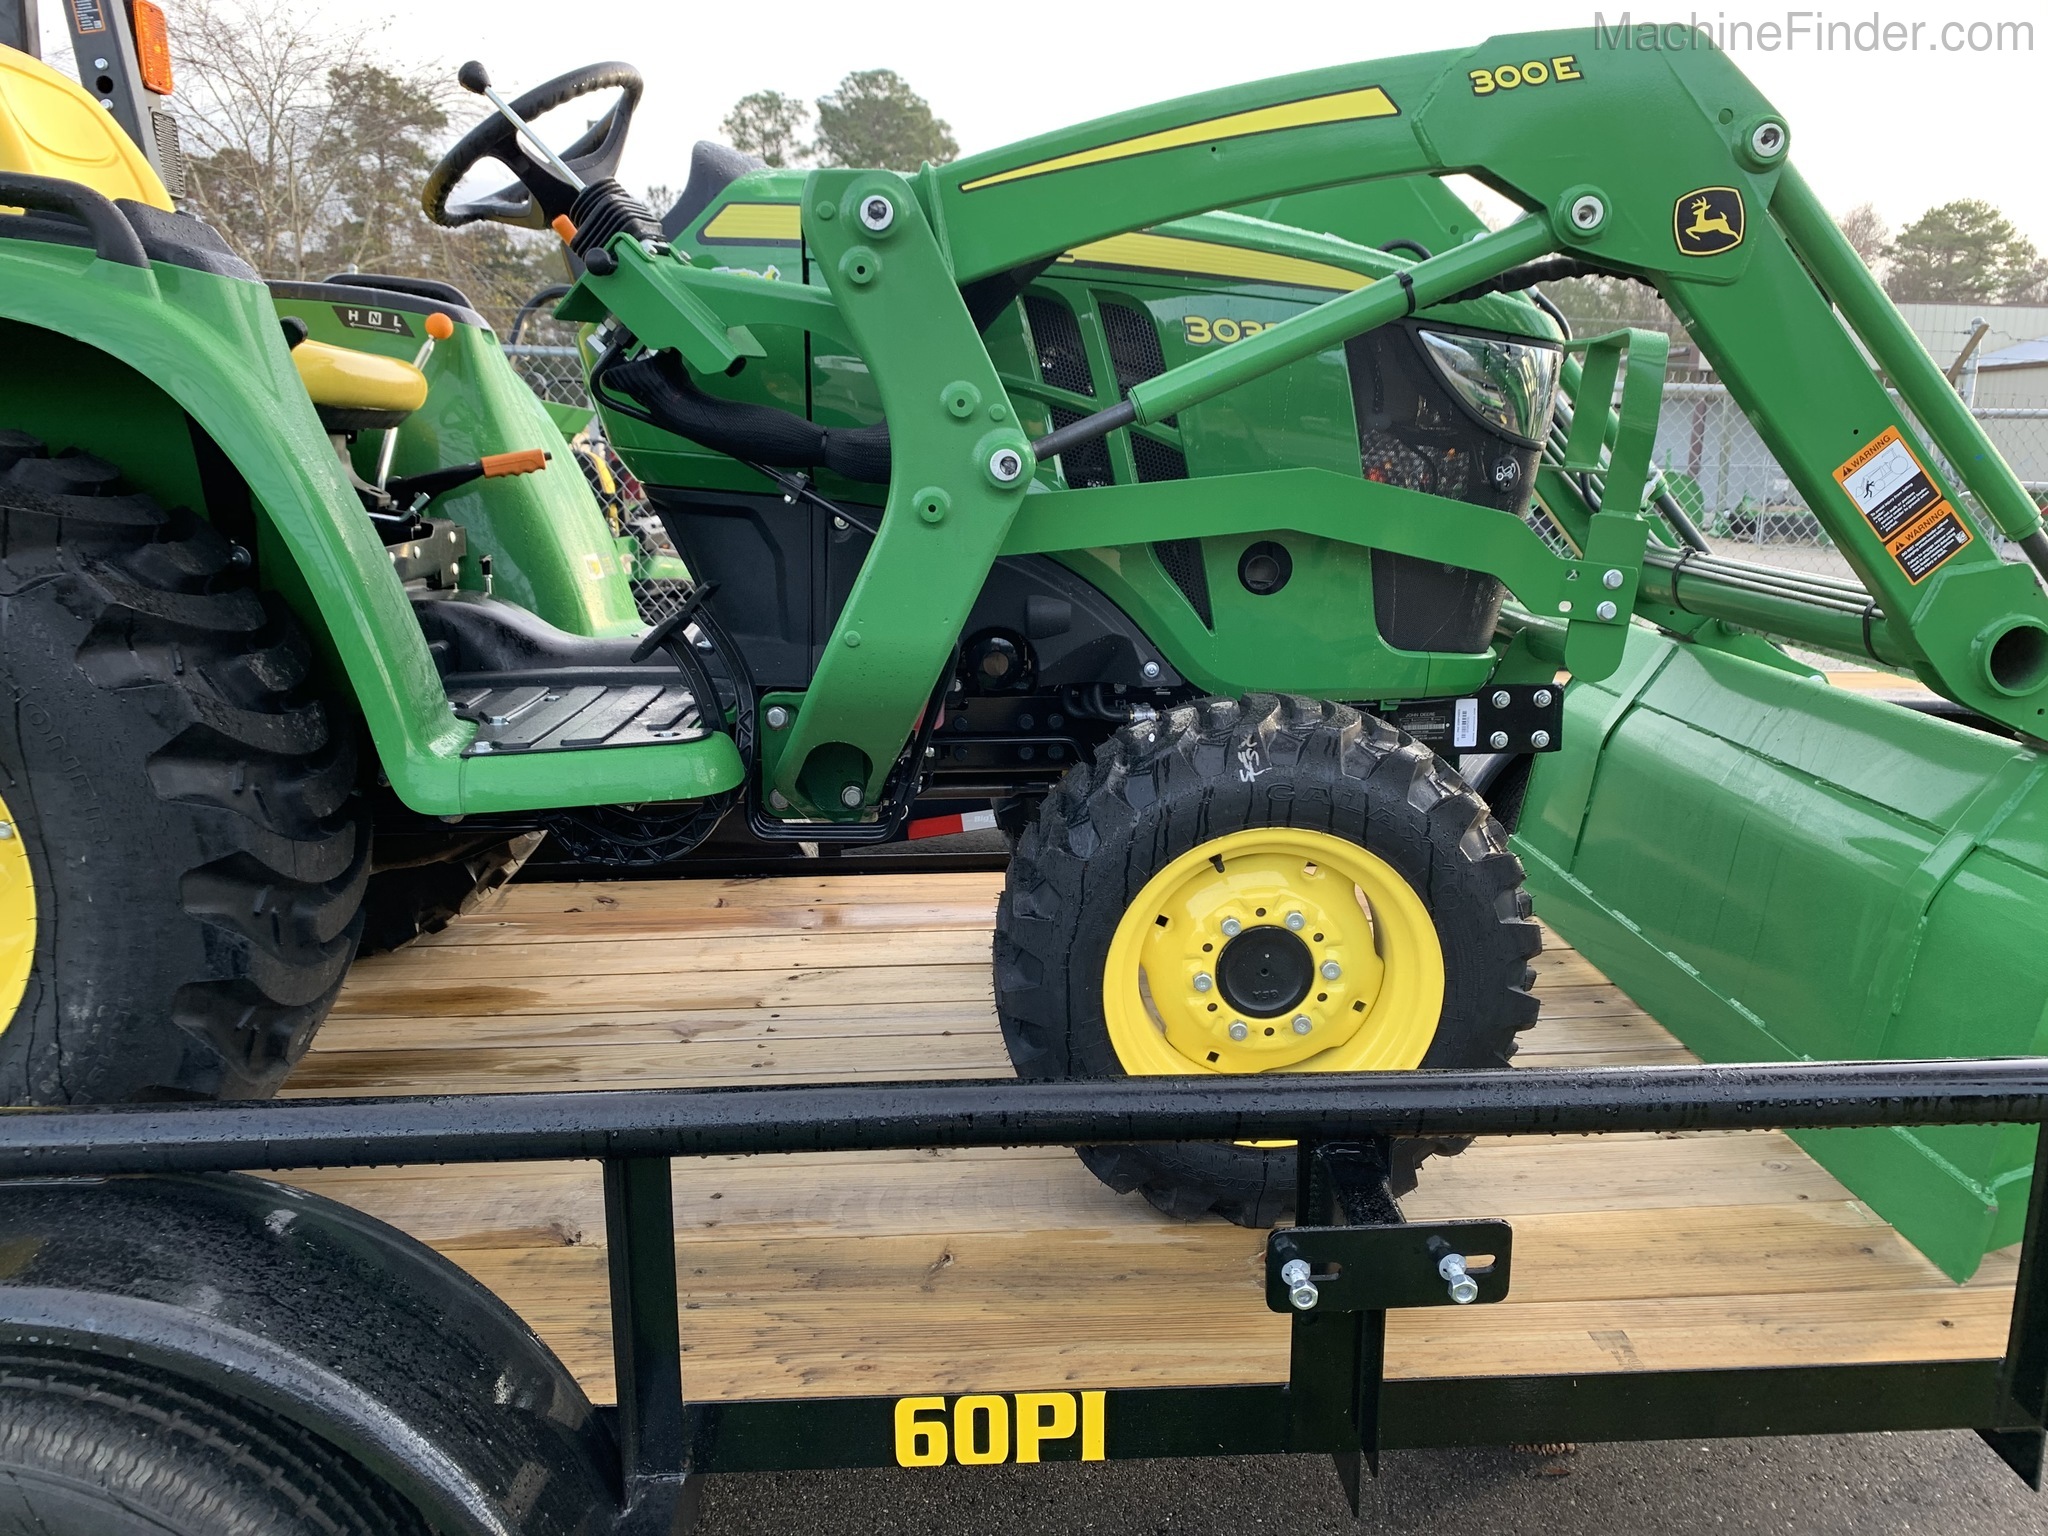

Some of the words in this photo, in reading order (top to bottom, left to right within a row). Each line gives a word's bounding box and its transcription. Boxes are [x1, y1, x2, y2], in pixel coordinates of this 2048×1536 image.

[348, 310, 359, 321] H
[369, 312, 381, 325] N
[393, 315, 402, 327] L
[1850, 434, 1891, 468] WARNING
[1904, 508, 1944, 541] WARNING
[894, 1391, 1106, 1467] 60PI
